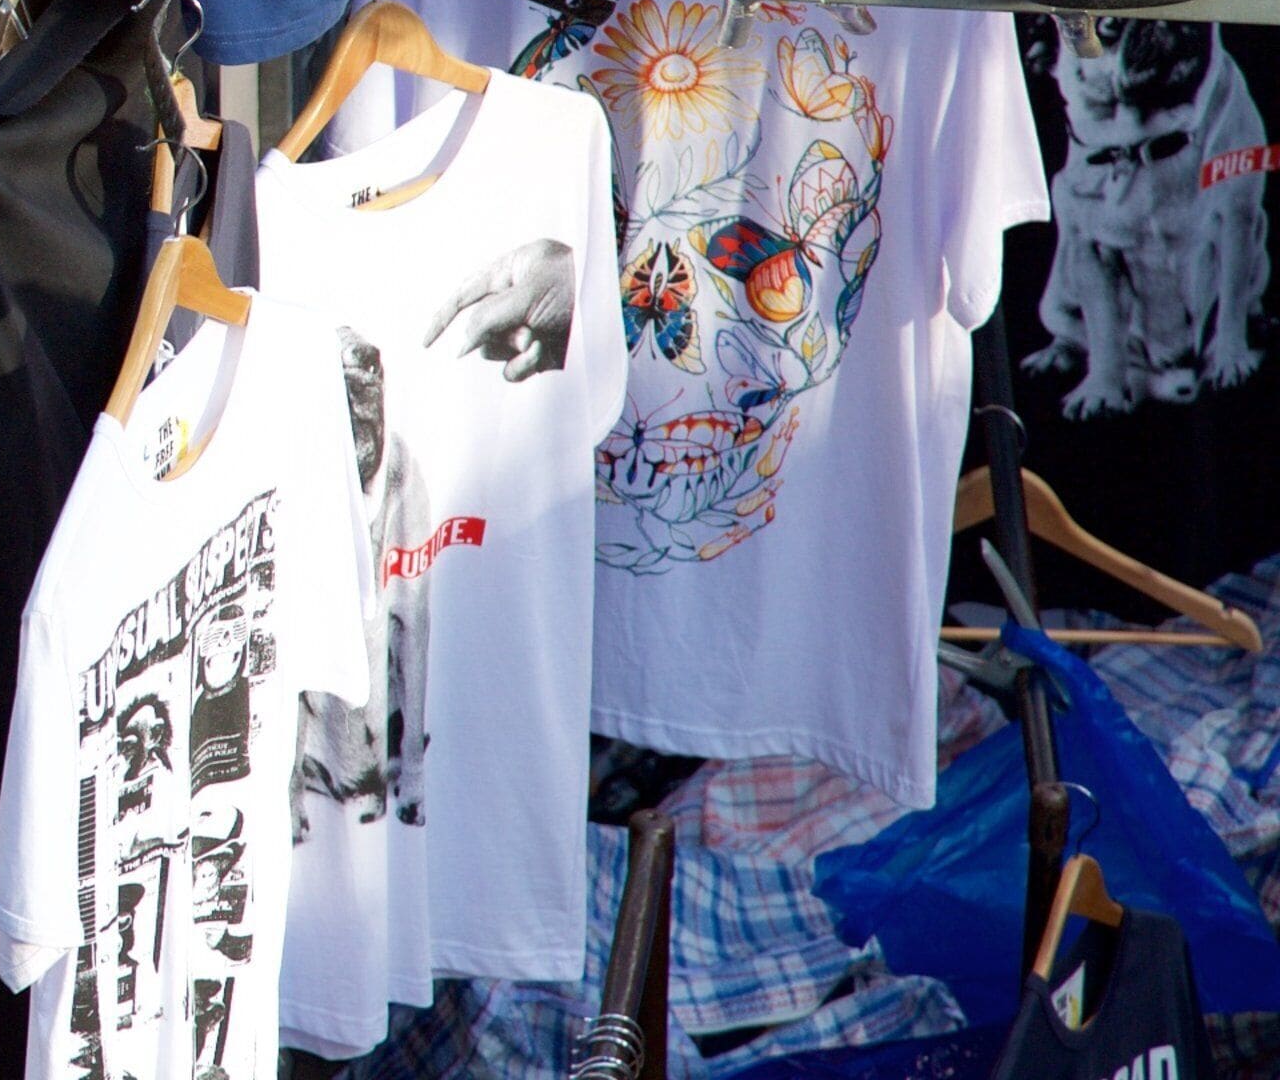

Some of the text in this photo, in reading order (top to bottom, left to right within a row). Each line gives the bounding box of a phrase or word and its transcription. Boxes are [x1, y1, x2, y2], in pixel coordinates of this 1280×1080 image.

[1210, 149, 1254, 181] PUG
[352, 187, 372, 208] THE
[158, 417, 173, 444] THE
[156, 441, 174, 468] FREE
[387, 550, 429, 578] PUG
